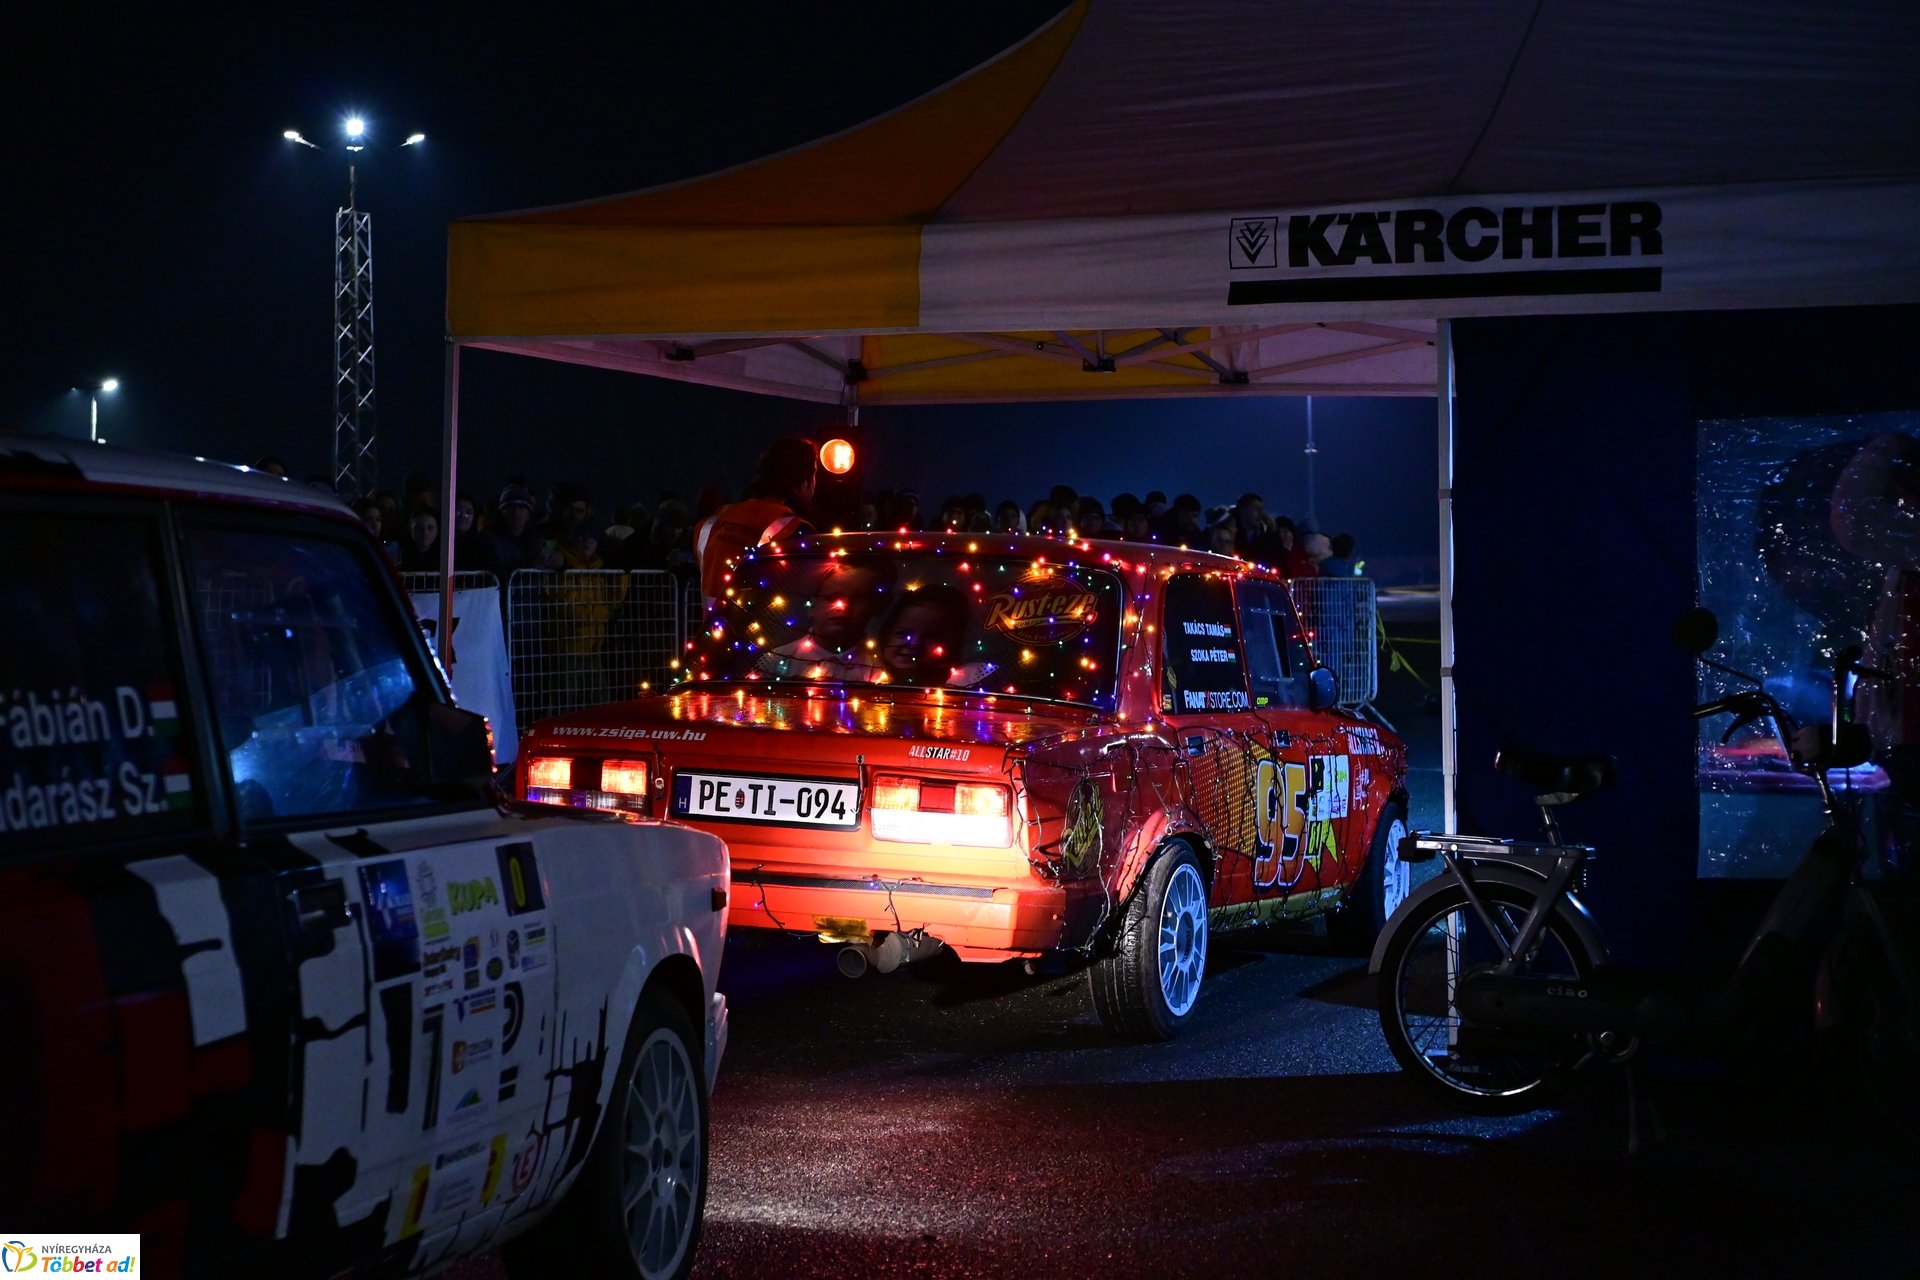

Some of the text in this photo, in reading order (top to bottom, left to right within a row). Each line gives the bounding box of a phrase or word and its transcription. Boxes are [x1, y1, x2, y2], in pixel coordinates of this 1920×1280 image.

[1288, 201, 1663, 267] KÄRCHER
[1183, 619, 1225, 637] TAKÁCS TAMÁS
[1190, 646, 1229, 662] SZOKA PÉTER
[116, 685, 154, 739] D.
[552, 726, 707, 741] www.zsiga.uw.hu
[0, 761, 169, 832] darász Sz.
[678, 779, 846, 820] H PE TI-094
[1254, 759, 1309, 887] 95
